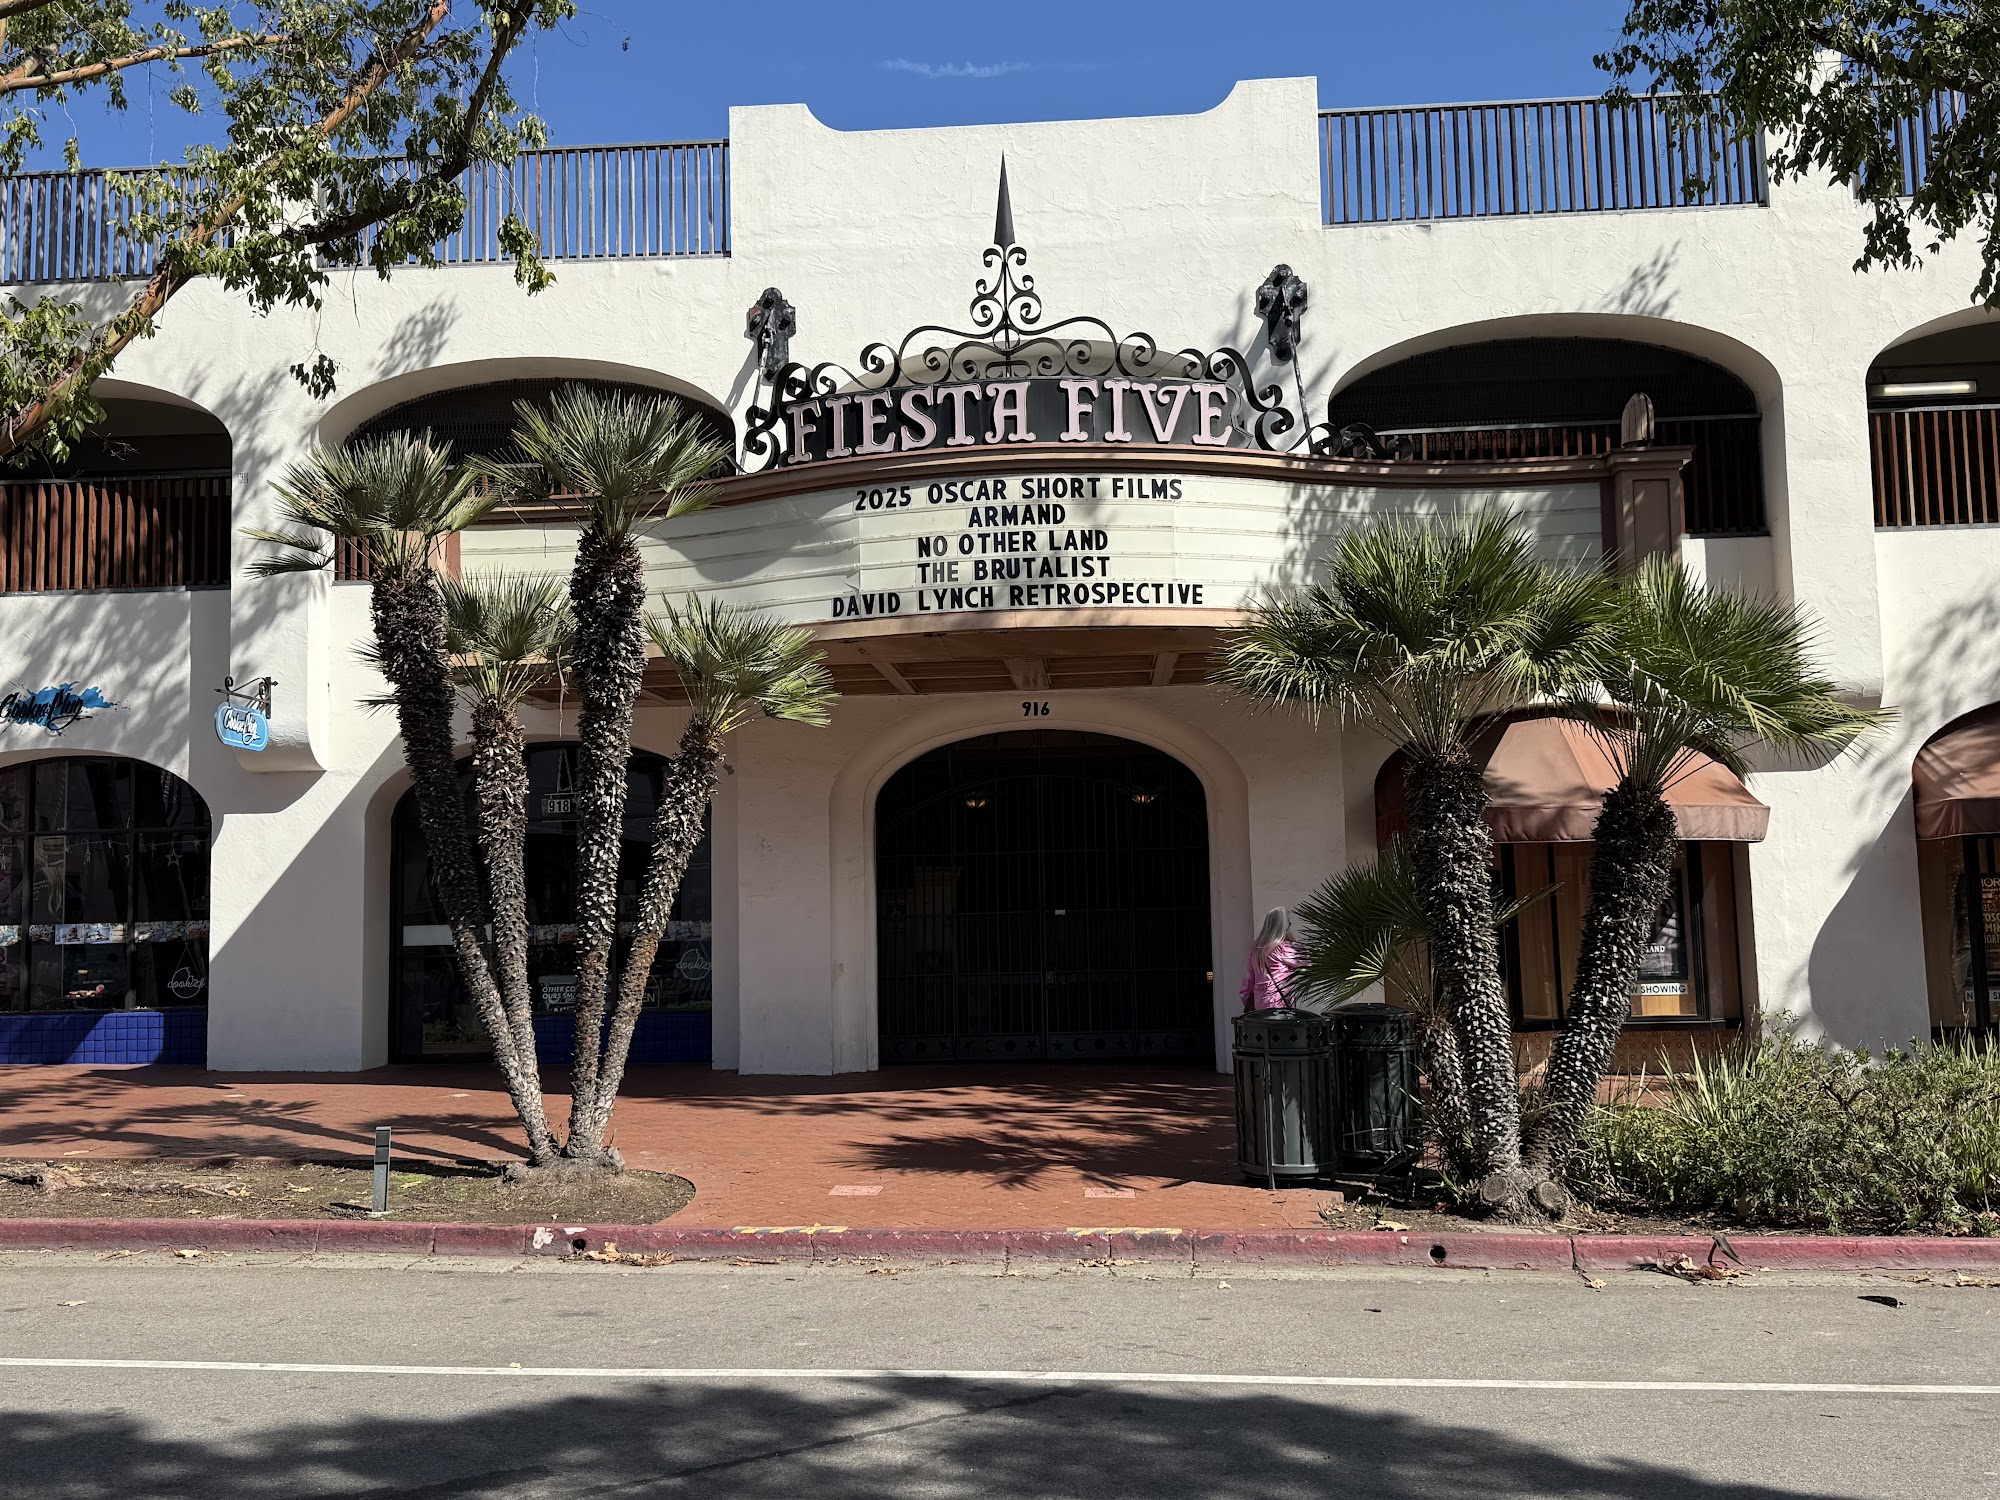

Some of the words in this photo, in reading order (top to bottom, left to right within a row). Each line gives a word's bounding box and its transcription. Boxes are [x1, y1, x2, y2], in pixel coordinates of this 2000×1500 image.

[786, 380, 1038, 465] FIESTA
[1059, 379, 1234, 446] FIVE
[856, 485, 912, 511] 2025
[928, 479, 1007, 505] OSCAR
[1021, 477, 1102, 500] SHORT
[1112, 478, 1182, 500] FILMS
[968, 503, 1066, 528] ARMAND
[917, 534, 948, 558] NO
[959, 531, 1036, 555] OTHER
[1049, 530, 1108, 552] LAND
[917, 561, 959, 584] THE
[974, 556, 1110, 581] BRUTALIST
[832, 592, 901, 618] DAVID
[919, 587, 994, 611] LYNCH
[1010, 583, 1203, 607] RETROSPECTIVE
[1021, 702, 1050, 716] 916
[548, 800, 570, 813] 918
[1640, 984, 1686, 994] SHOWING
